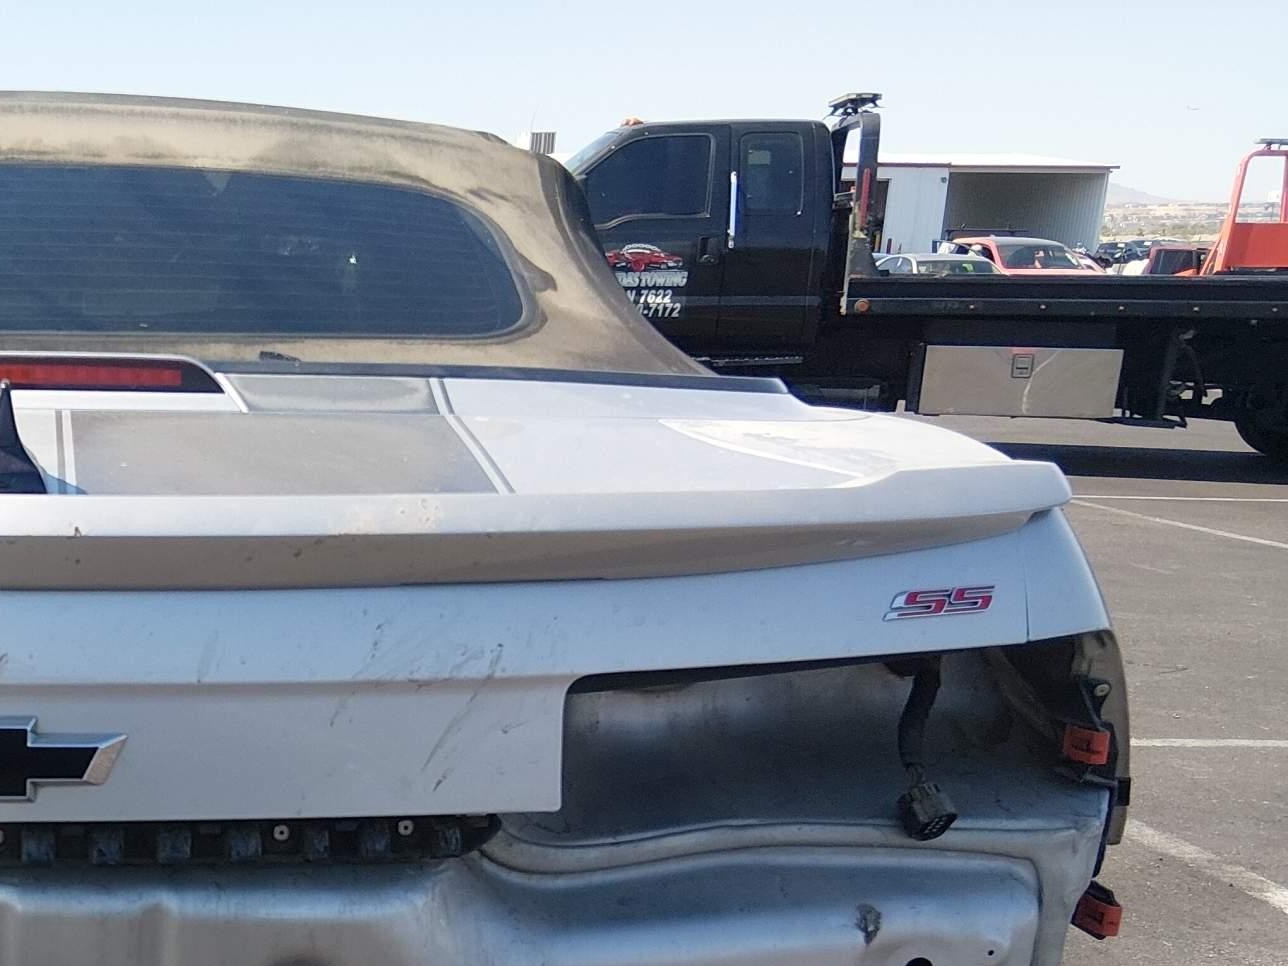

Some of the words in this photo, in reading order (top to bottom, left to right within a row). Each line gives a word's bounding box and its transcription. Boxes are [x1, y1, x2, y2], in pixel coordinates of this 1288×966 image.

[640, 271, 689, 287] TOWING
[640, 289, 673, 304] 7622
[882, 585, 996, 622] SS
